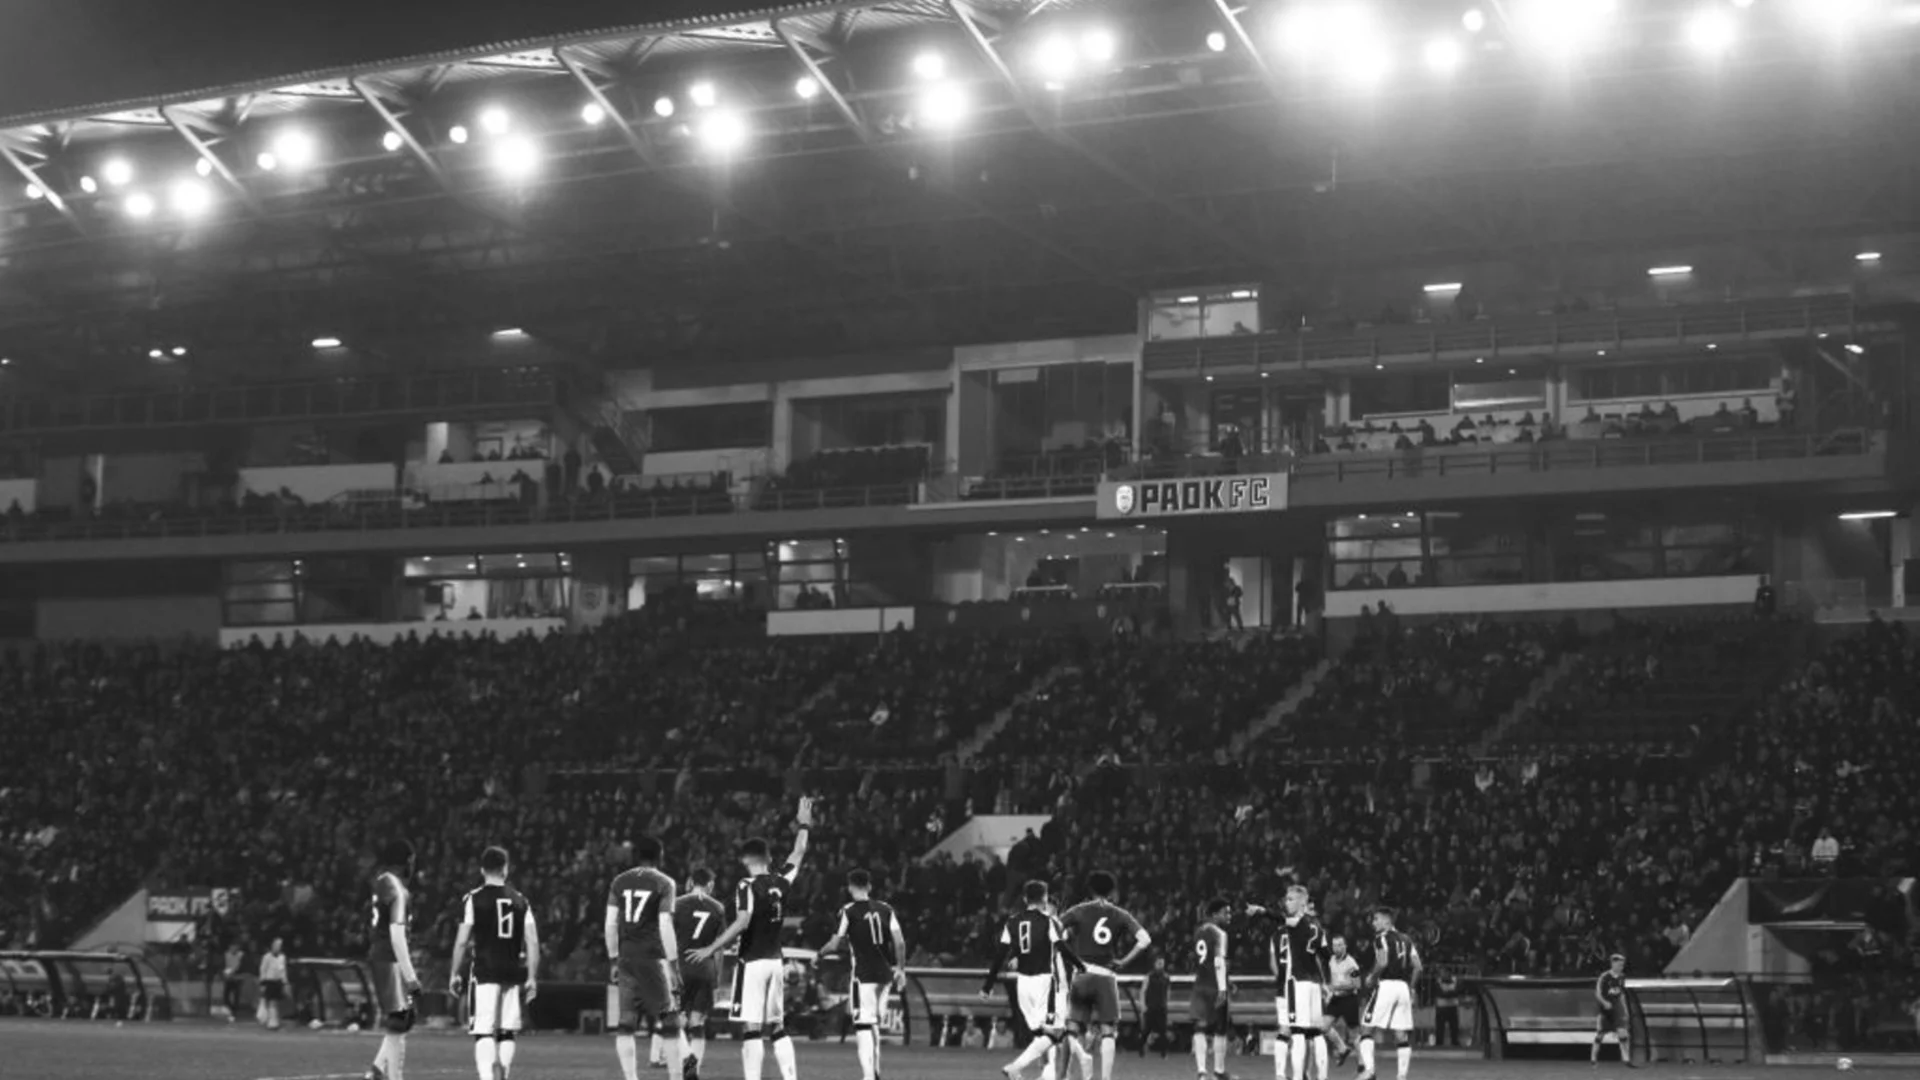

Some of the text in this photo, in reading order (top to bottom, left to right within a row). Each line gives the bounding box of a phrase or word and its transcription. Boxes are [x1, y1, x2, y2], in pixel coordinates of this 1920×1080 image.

[1141, 477, 1270, 513] PAOK FC
[496, 898, 514, 939] 6
[622, 889, 652, 923] 17
[768, 887, 782, 923] 3
[692, 911, 711, 940] 7
[863, 911, 884, 945] 11
[1019, 920, 1031, 954] 8
[1093, 916, 1112, 945] 6
[1306, 924, 1319, 954] 2
[1196, 939, 1208, 964] 9
[1396, 940, 1407, 969] 4
